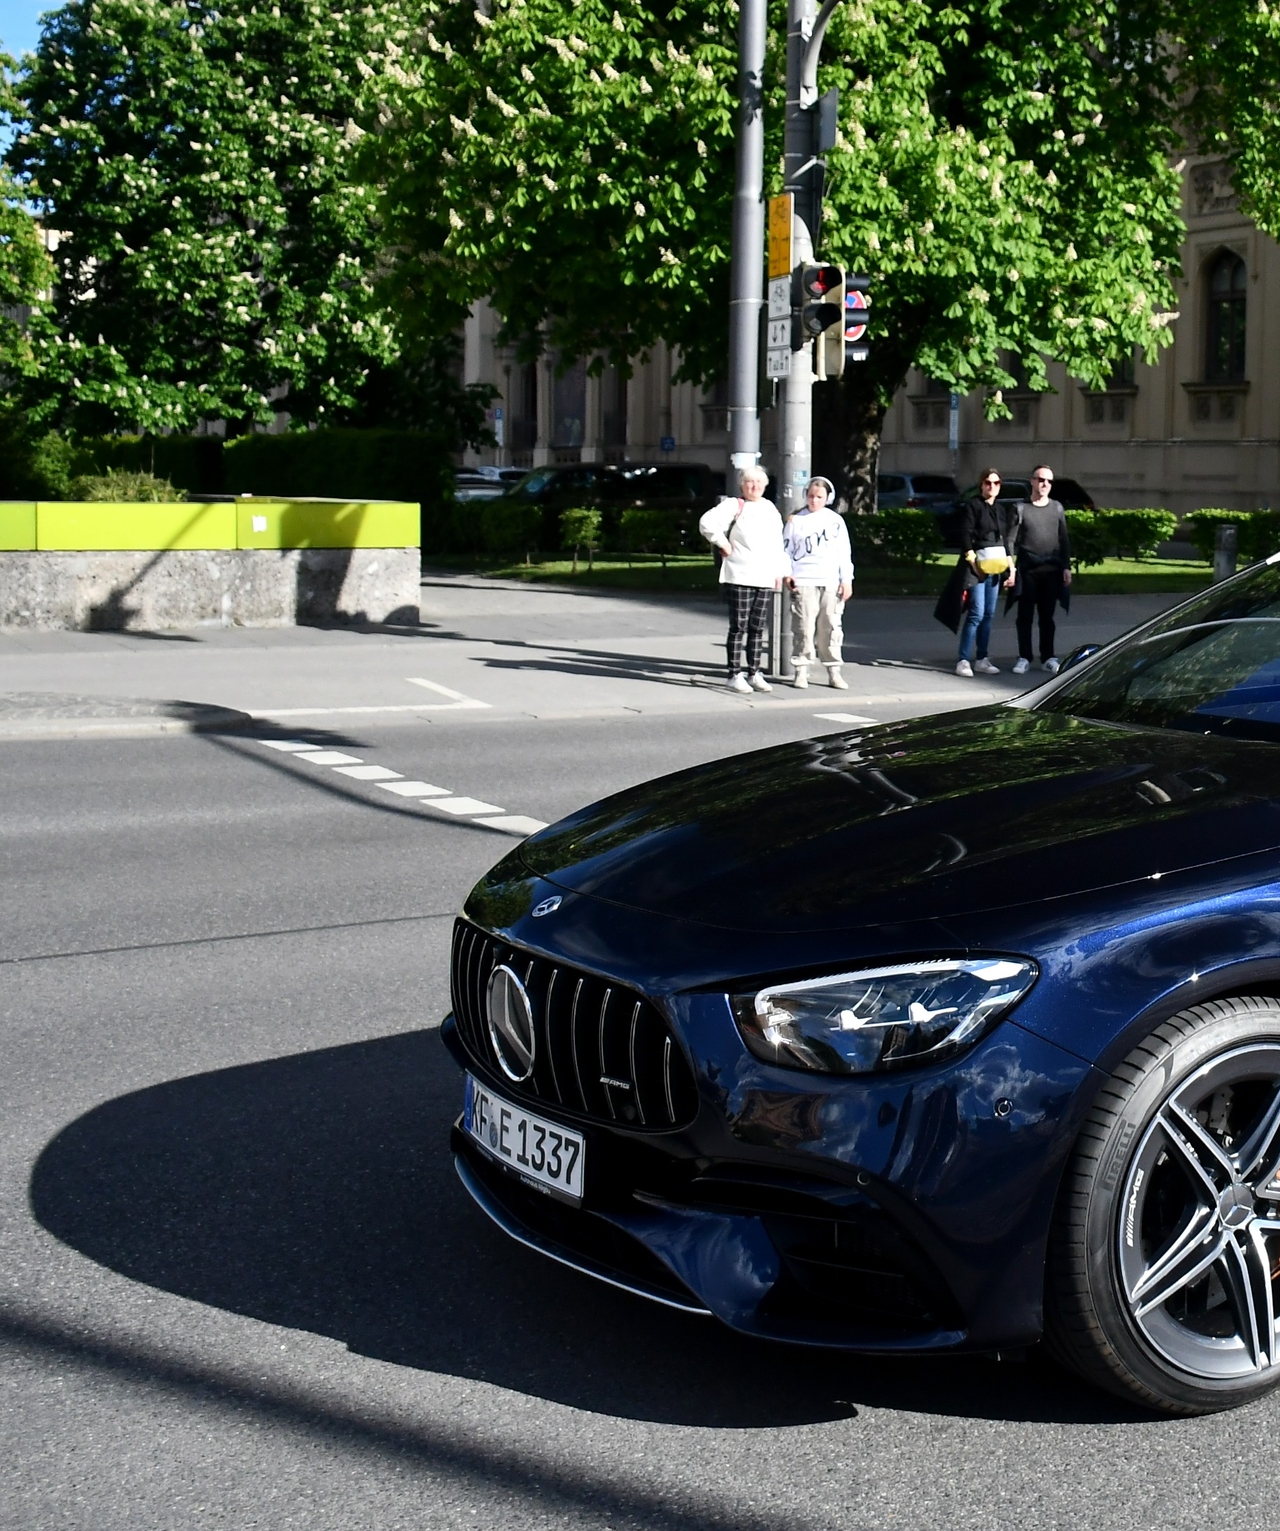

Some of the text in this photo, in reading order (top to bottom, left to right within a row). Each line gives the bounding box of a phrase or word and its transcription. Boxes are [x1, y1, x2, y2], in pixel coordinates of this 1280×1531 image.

[607, 1078, 630, 1090] AMG
[471, 1085, 581, 1186] KF E 1337
[1098, 1118, 1137, 1192] PIRELLI
[1127, 1168, 1145, 1224] AMG
